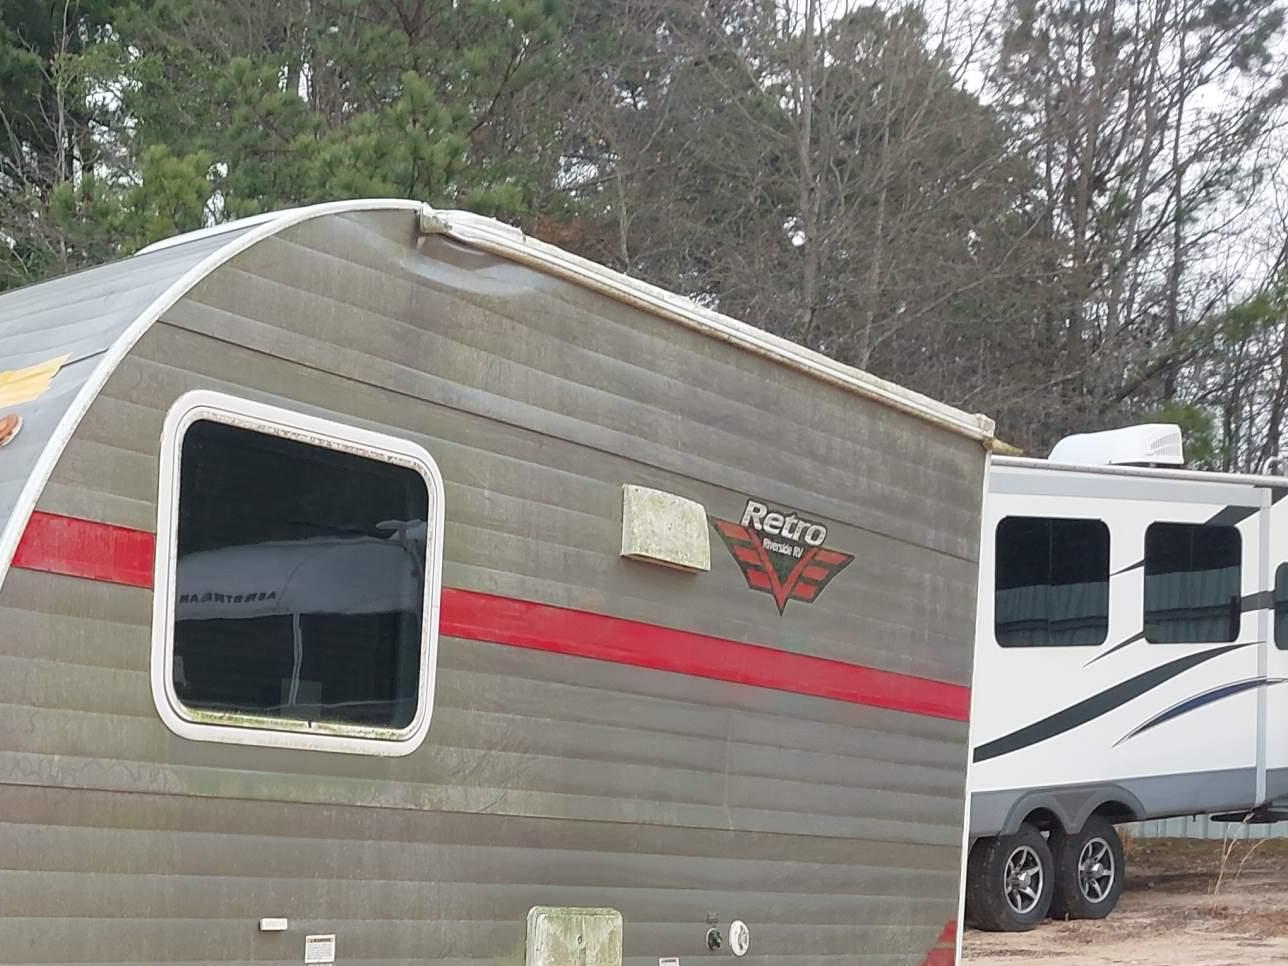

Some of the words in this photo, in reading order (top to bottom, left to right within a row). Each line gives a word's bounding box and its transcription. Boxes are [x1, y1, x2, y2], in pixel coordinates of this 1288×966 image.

[741, 500, 827, 546] Retro
[763, 538, 793, 556] Riverside
[793, 546, 804, 558] RV
